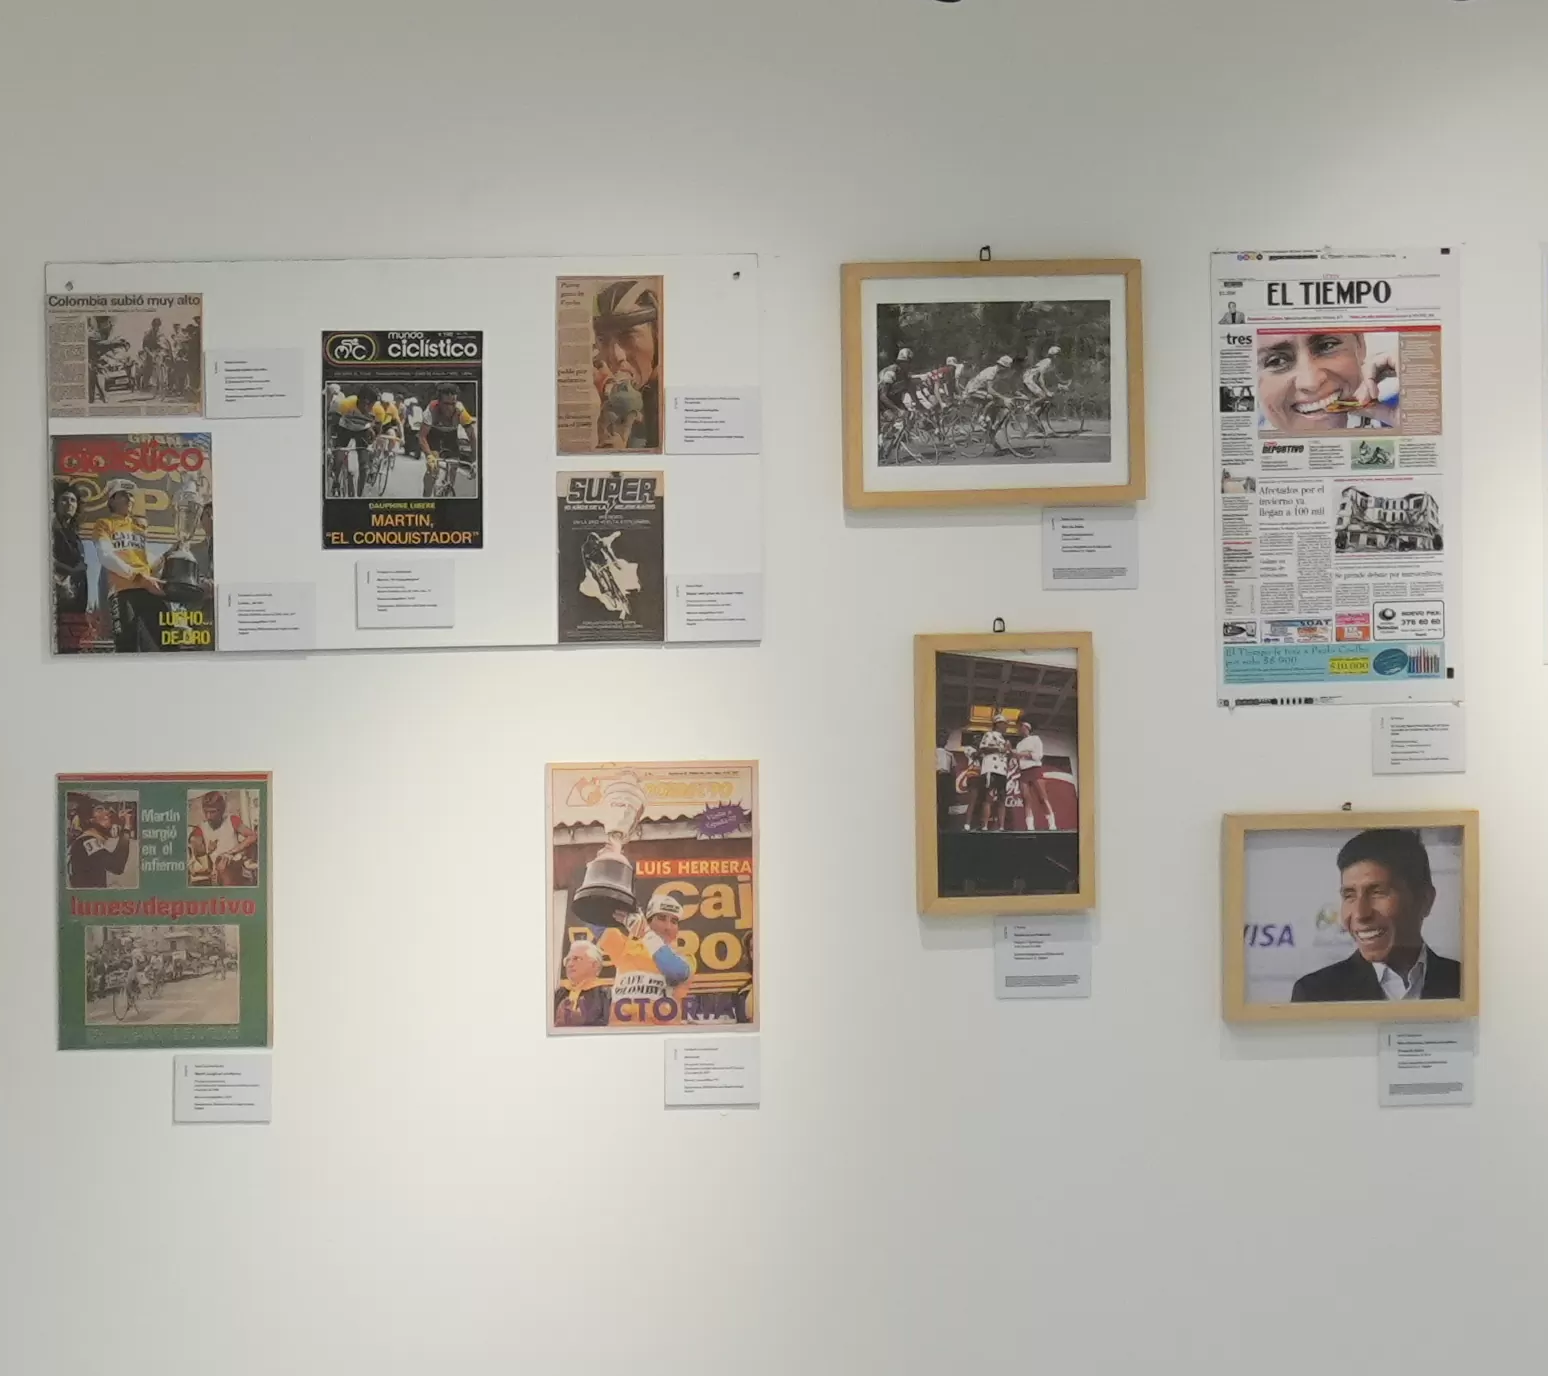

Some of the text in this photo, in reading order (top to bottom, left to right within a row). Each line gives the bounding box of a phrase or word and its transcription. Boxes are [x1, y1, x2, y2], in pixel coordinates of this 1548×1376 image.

[1267, 280, 1391, 306] EL TIEMPO
[48, 295, 200, 308] Colombia subió muy alto
[388, 331, 424, 339] mundo
[1226, 333, 1253, 345] tres
[388, 339, 478, 358] ciclístico
[566, 477, 657, 504] SUPER
[1259, 485, 1325, 496] Afectados por el
[1259, 496, 1294, 506] invierno
[1259, 507, 1283, 518] llegan
[1294, 506, 1308, 516] 100
[1311, 506, 1325, 516] mil
[371, 514, 434, 528] MARTIN,
[141, 807, 181, 822] Martín
[141, 827, 178, 840] surgió
[142, 843, 173, 855] en el
[141, 858, 185, 872] infierno
[635, 859, 752, 875] LUIS HERRERA
